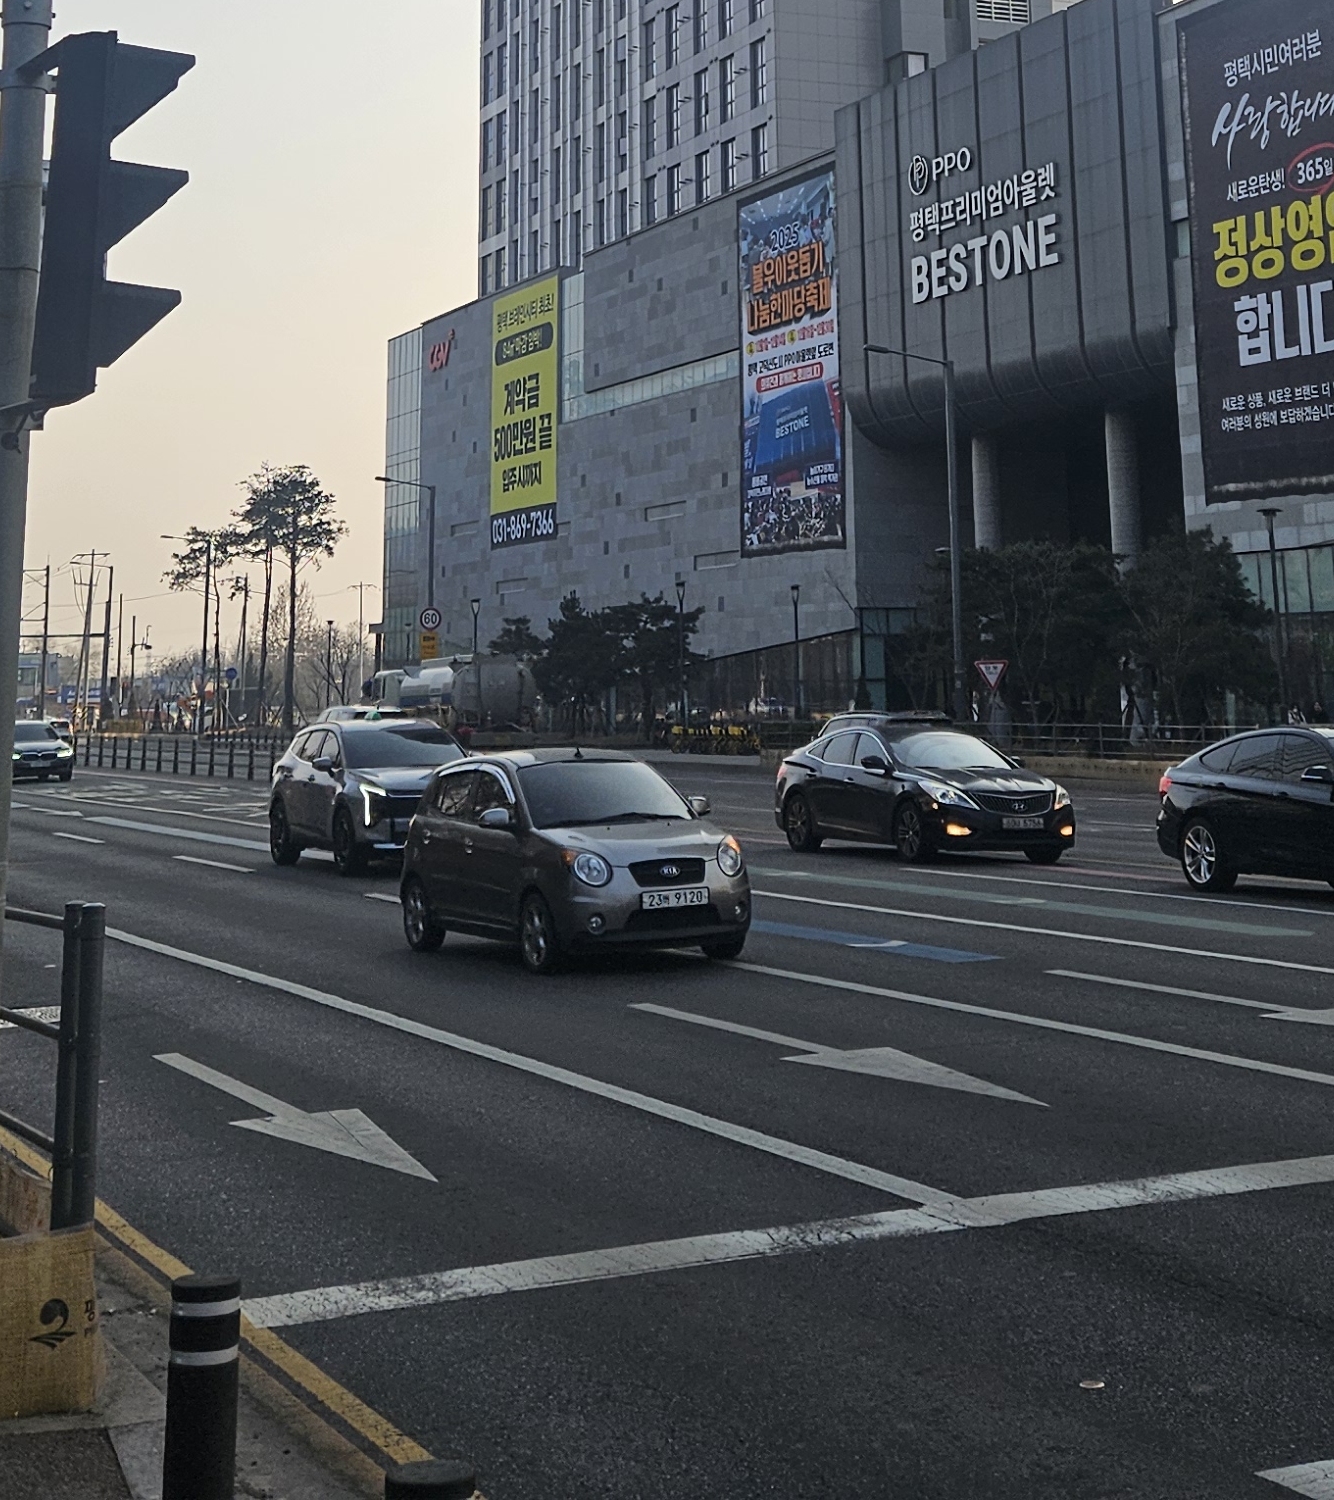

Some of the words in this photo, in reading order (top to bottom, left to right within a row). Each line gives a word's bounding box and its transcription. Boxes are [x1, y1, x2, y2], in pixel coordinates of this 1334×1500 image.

[1224, 29, 1322, 87] 평택시민여러분
[932, 147, 971, 182] PPO
[1297, 157, 1334, 184] 365일
[909, 162, 1057, 242] 평택프리미엄아울렛
[770, 222, 800, 252] 2025
[752, 241, 824, 295] 불우이웃돕기
[911, 213, 1059, 304] BESTONE
[747, 277, 832, 332] 나눔한마당축제
[504, 373, 540, 416] 계약금
[1222, 394, 1246, 411] 새로운
[1268, 387, 1292, 405] 새로운
[1294, 384, 1319, 401] 브랜드
[1321, 382, 1331, 398] 더
[494, 417, 536, 462] 500만원
[539, 413, 552, 450] 끝
[775, 415, 809, 439] BESTONE
[1221, 414, 1252, 432] 여러분의
[1254, 411, 1277, 429] 성원에
[493, 509, 554, 544] 031-869-7366
[424, 612, 437, 625] 60
[662, 866, 678, 875] KIA
[674, 890, 703, 904] 9120
